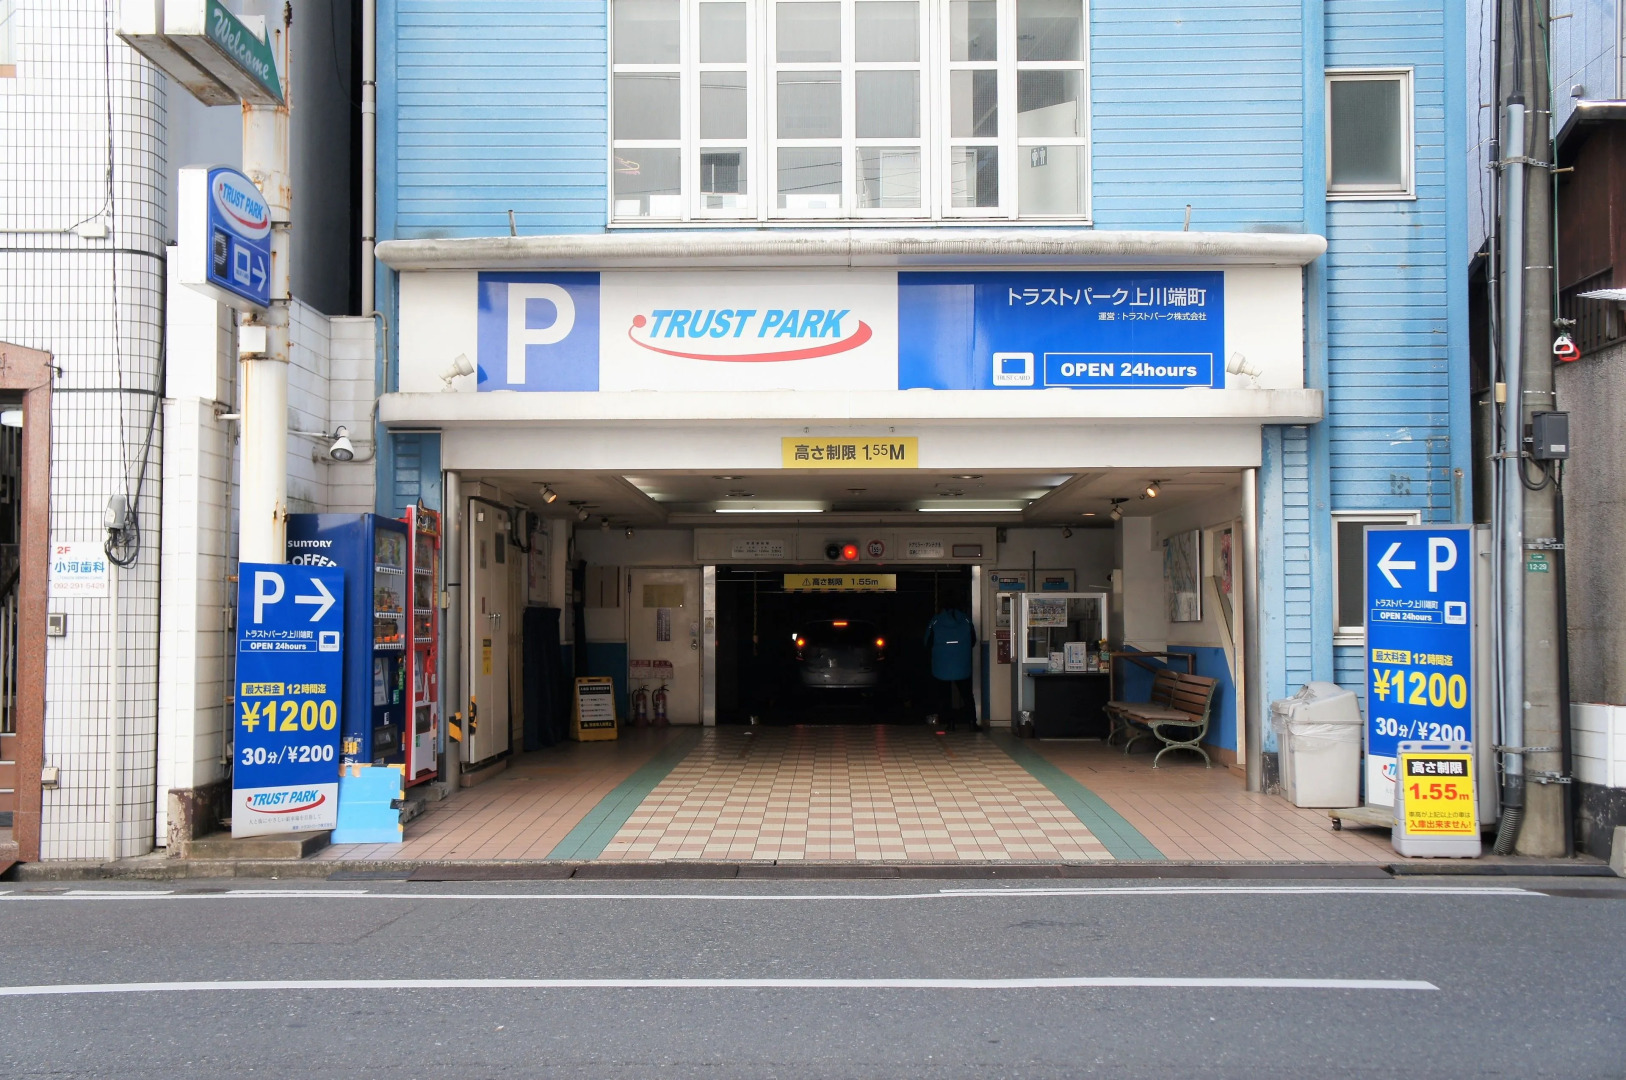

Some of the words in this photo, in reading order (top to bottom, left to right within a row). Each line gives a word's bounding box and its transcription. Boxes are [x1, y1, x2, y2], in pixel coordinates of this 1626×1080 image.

[213, 7, 269, 80] Welcome
[223, 183, 245, 209] TRUST
[245, 197, 264, 221] PARK
[1007, 287, 1207, 307] トラストパーク上川端町
[648, 309, 757, 338] TRUST
[758, 309, 851, 338] PARK
[506, 282, 576, 385] P
[1060, 362, 1114, 377] OPEN
[1120, 362, 1197, 377] 24hours
[794, 444, 856, 461] 高さ制限
[862, 444, 905, 461] 1.55M
[56, 546, 71, 555] 2F
[54, 561, 105, 573] 小河歯科
[1428, 536, 1458, 593] P
[812, 577, 843, 586] 高さ制限
[851, 578, 879, 586] 1.55m
[253, 571, 285, 624] P
[1375, 598, 1439, 610] トラストパーク上川端町
[1380, 611, 1401, 620] OPEN
[1402, 612, 1432, 622] 24hours
[245, 629, 314, 639] トラストパーク上川端町
[250, 642, 274, 650] OPEN
[275, 642, 307, 650] 24hours
[1375, 650, 1408, 663] 最大料金
[245, 684, 281, 695] 最大料金
[1372, 667, 1468, 710] ¥1200
[241, 699, 337, 733] ¥1200
[1411, 761, 1463, 775] 高さ制限
[252, 791, 288, 806] TRUST
[289, 789, 319, 804] PARK
[1409, 782, 1470, 801] 1.55m
